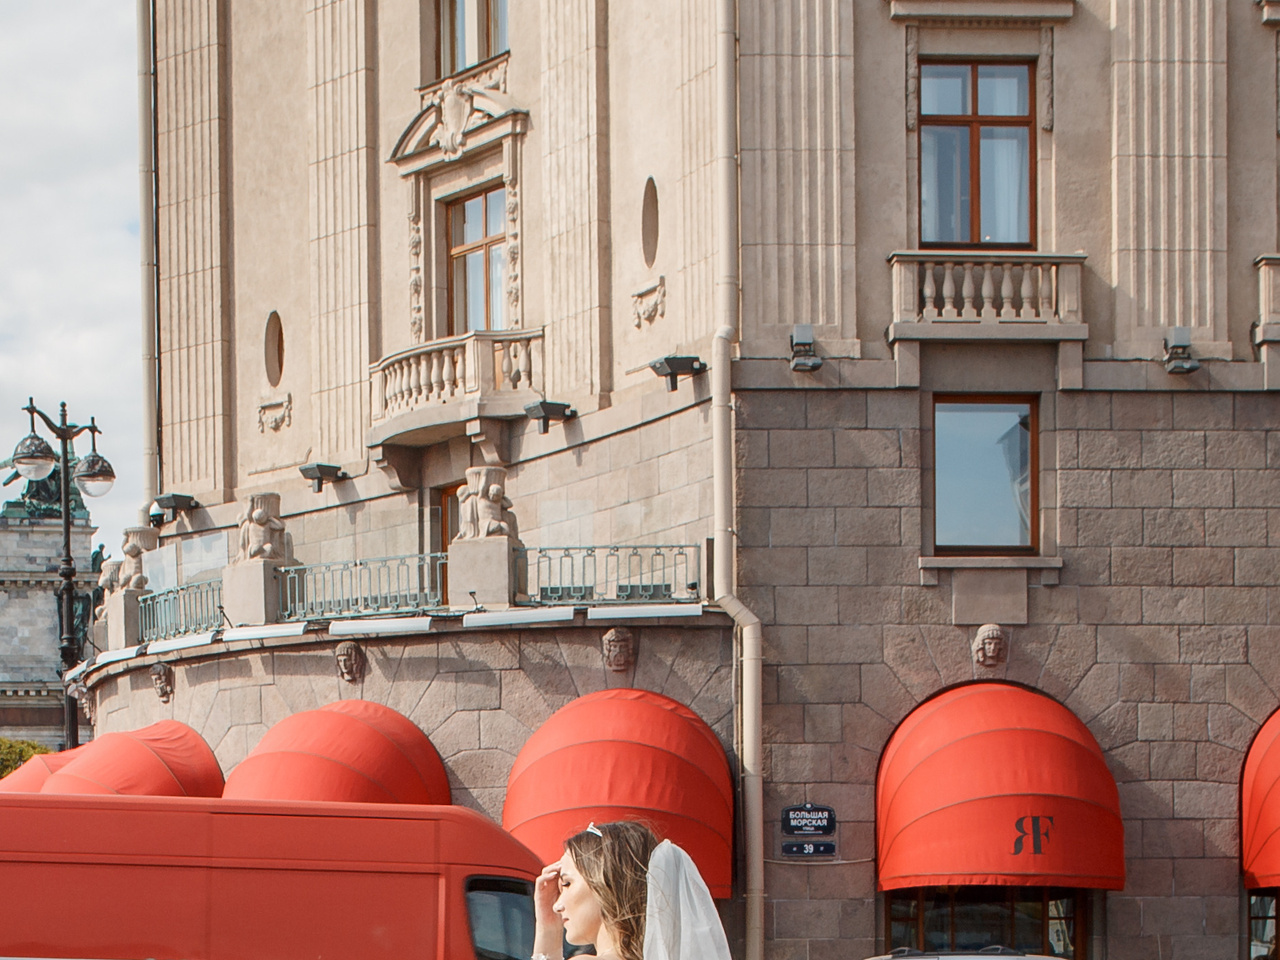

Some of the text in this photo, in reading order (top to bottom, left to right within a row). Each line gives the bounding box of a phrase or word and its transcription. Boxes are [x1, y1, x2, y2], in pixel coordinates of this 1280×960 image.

[789, 811, 829, 819] БОЛЬШАЯ
[790, 818, 828, 826] МОРСКАЯ
[803, 843, 814, 854] 39
